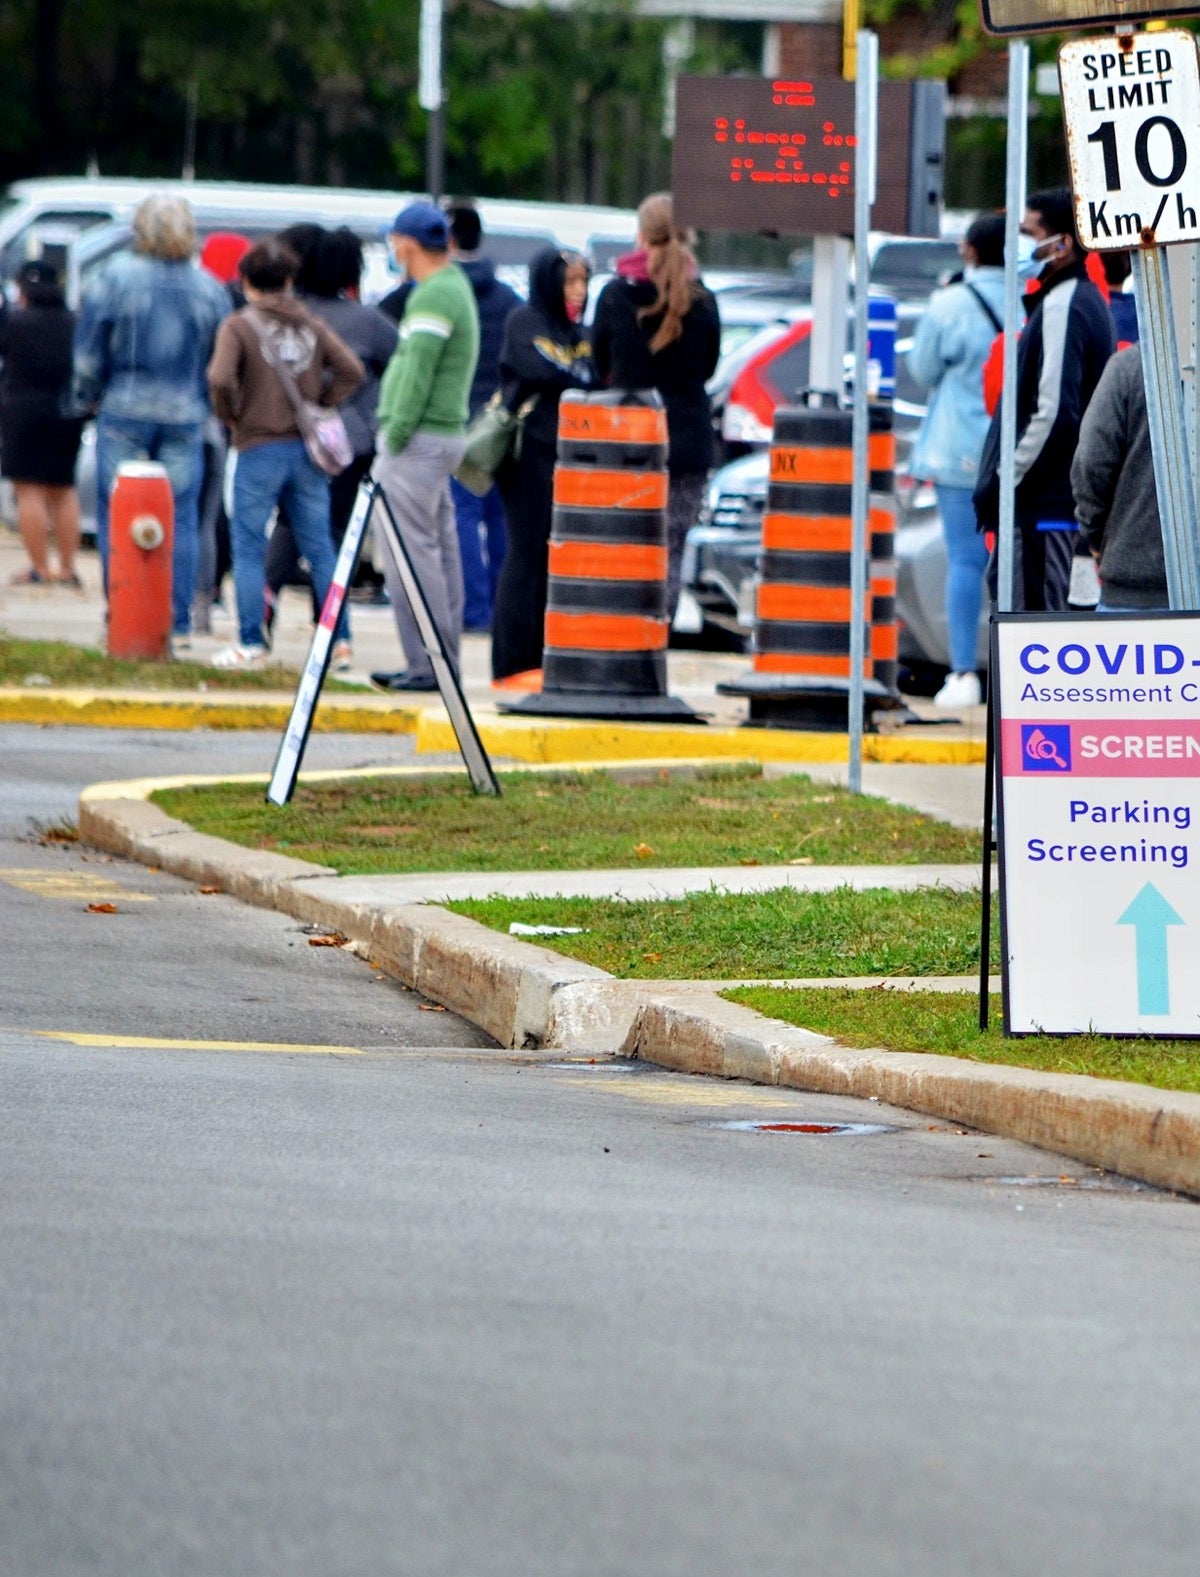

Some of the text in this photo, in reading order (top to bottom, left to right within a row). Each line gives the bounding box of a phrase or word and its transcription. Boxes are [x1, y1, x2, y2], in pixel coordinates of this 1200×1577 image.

[1082, 48, 1172, 81] SPEED
[1088, 80, 1173, 112] LIMIT
[1087, 115, 1187, 192] 10
[1088, 192, 1197, 239] Km/h
[1020, 682, 1172, 703] Assessment
[1069, 799, 1191, 829] Parking
[1026, 838, 1189, 868] Screening
